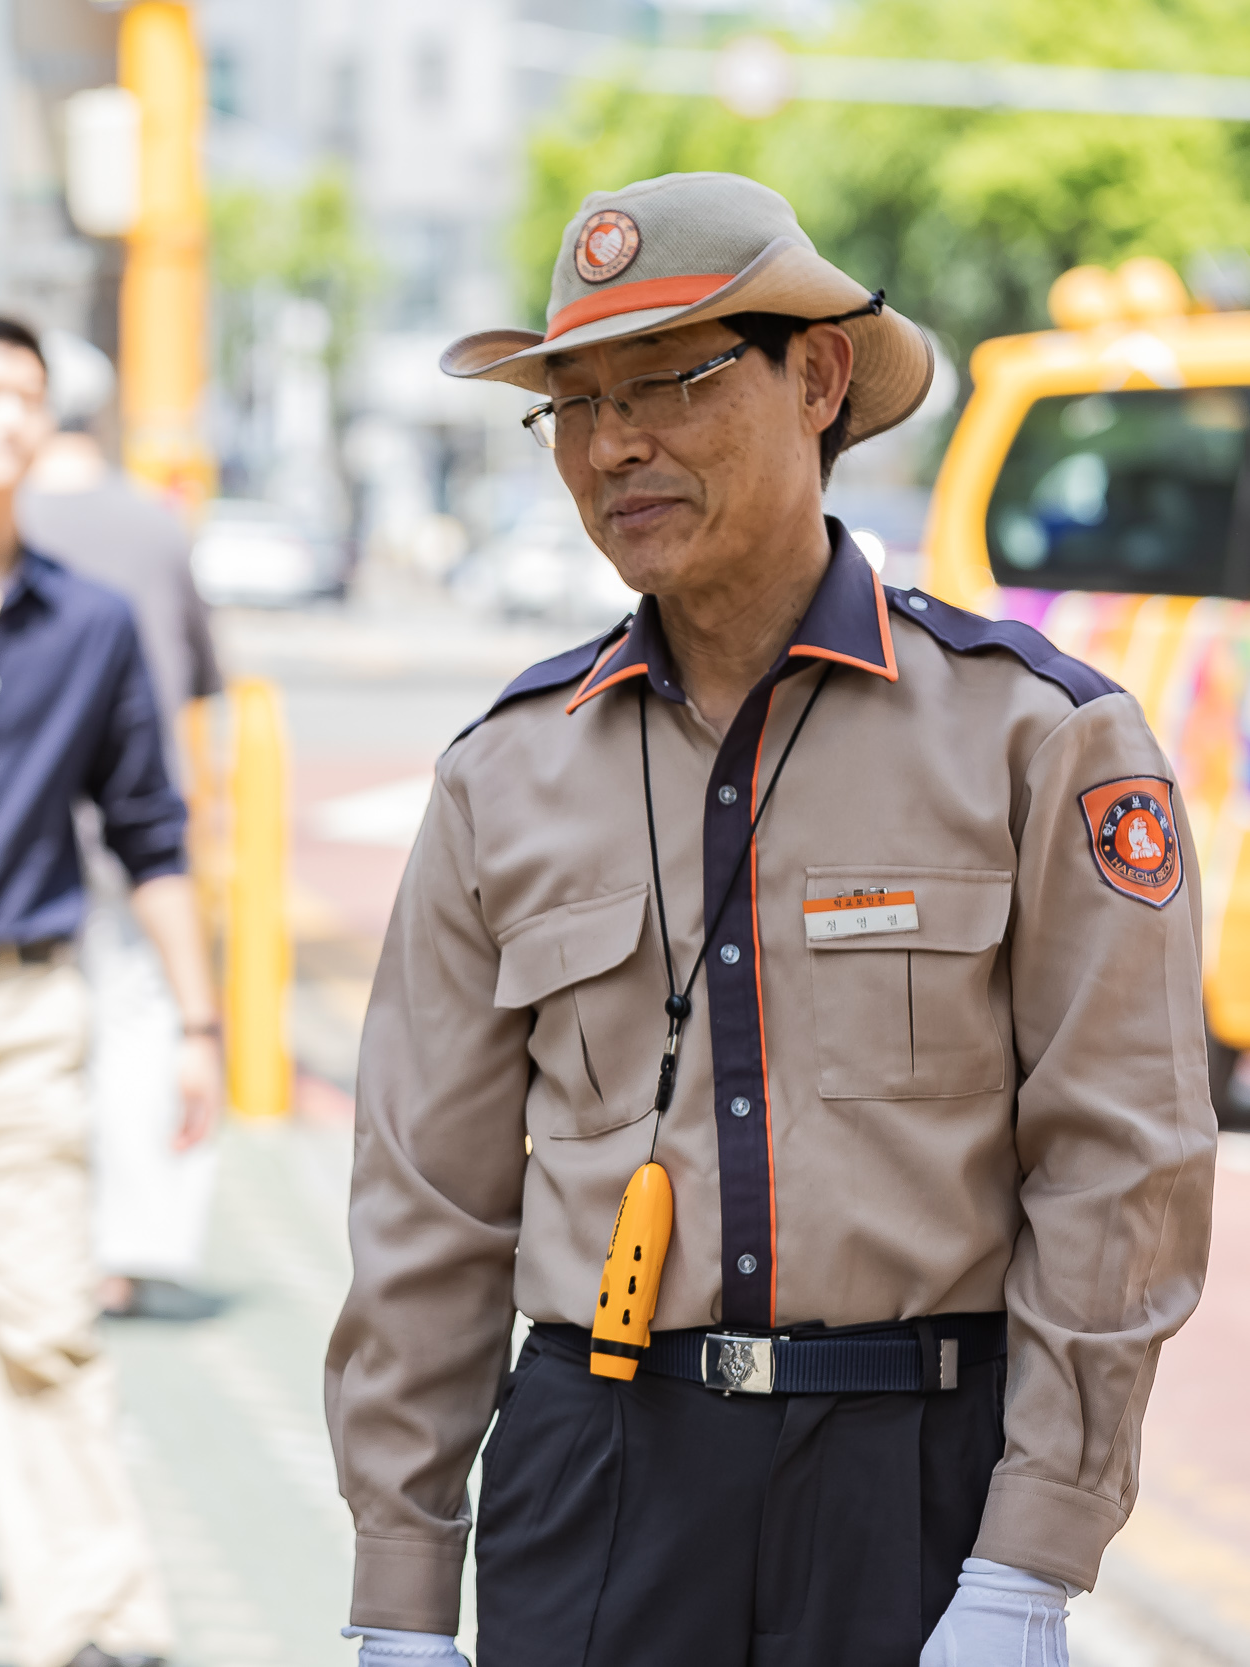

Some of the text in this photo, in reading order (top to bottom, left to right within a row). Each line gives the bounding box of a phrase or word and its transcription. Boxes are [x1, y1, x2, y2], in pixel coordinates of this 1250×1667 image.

[1102, 795, 1169, 837] 학교보안관
[1111, 851, 1173, 883] HAECHI SEOUL
